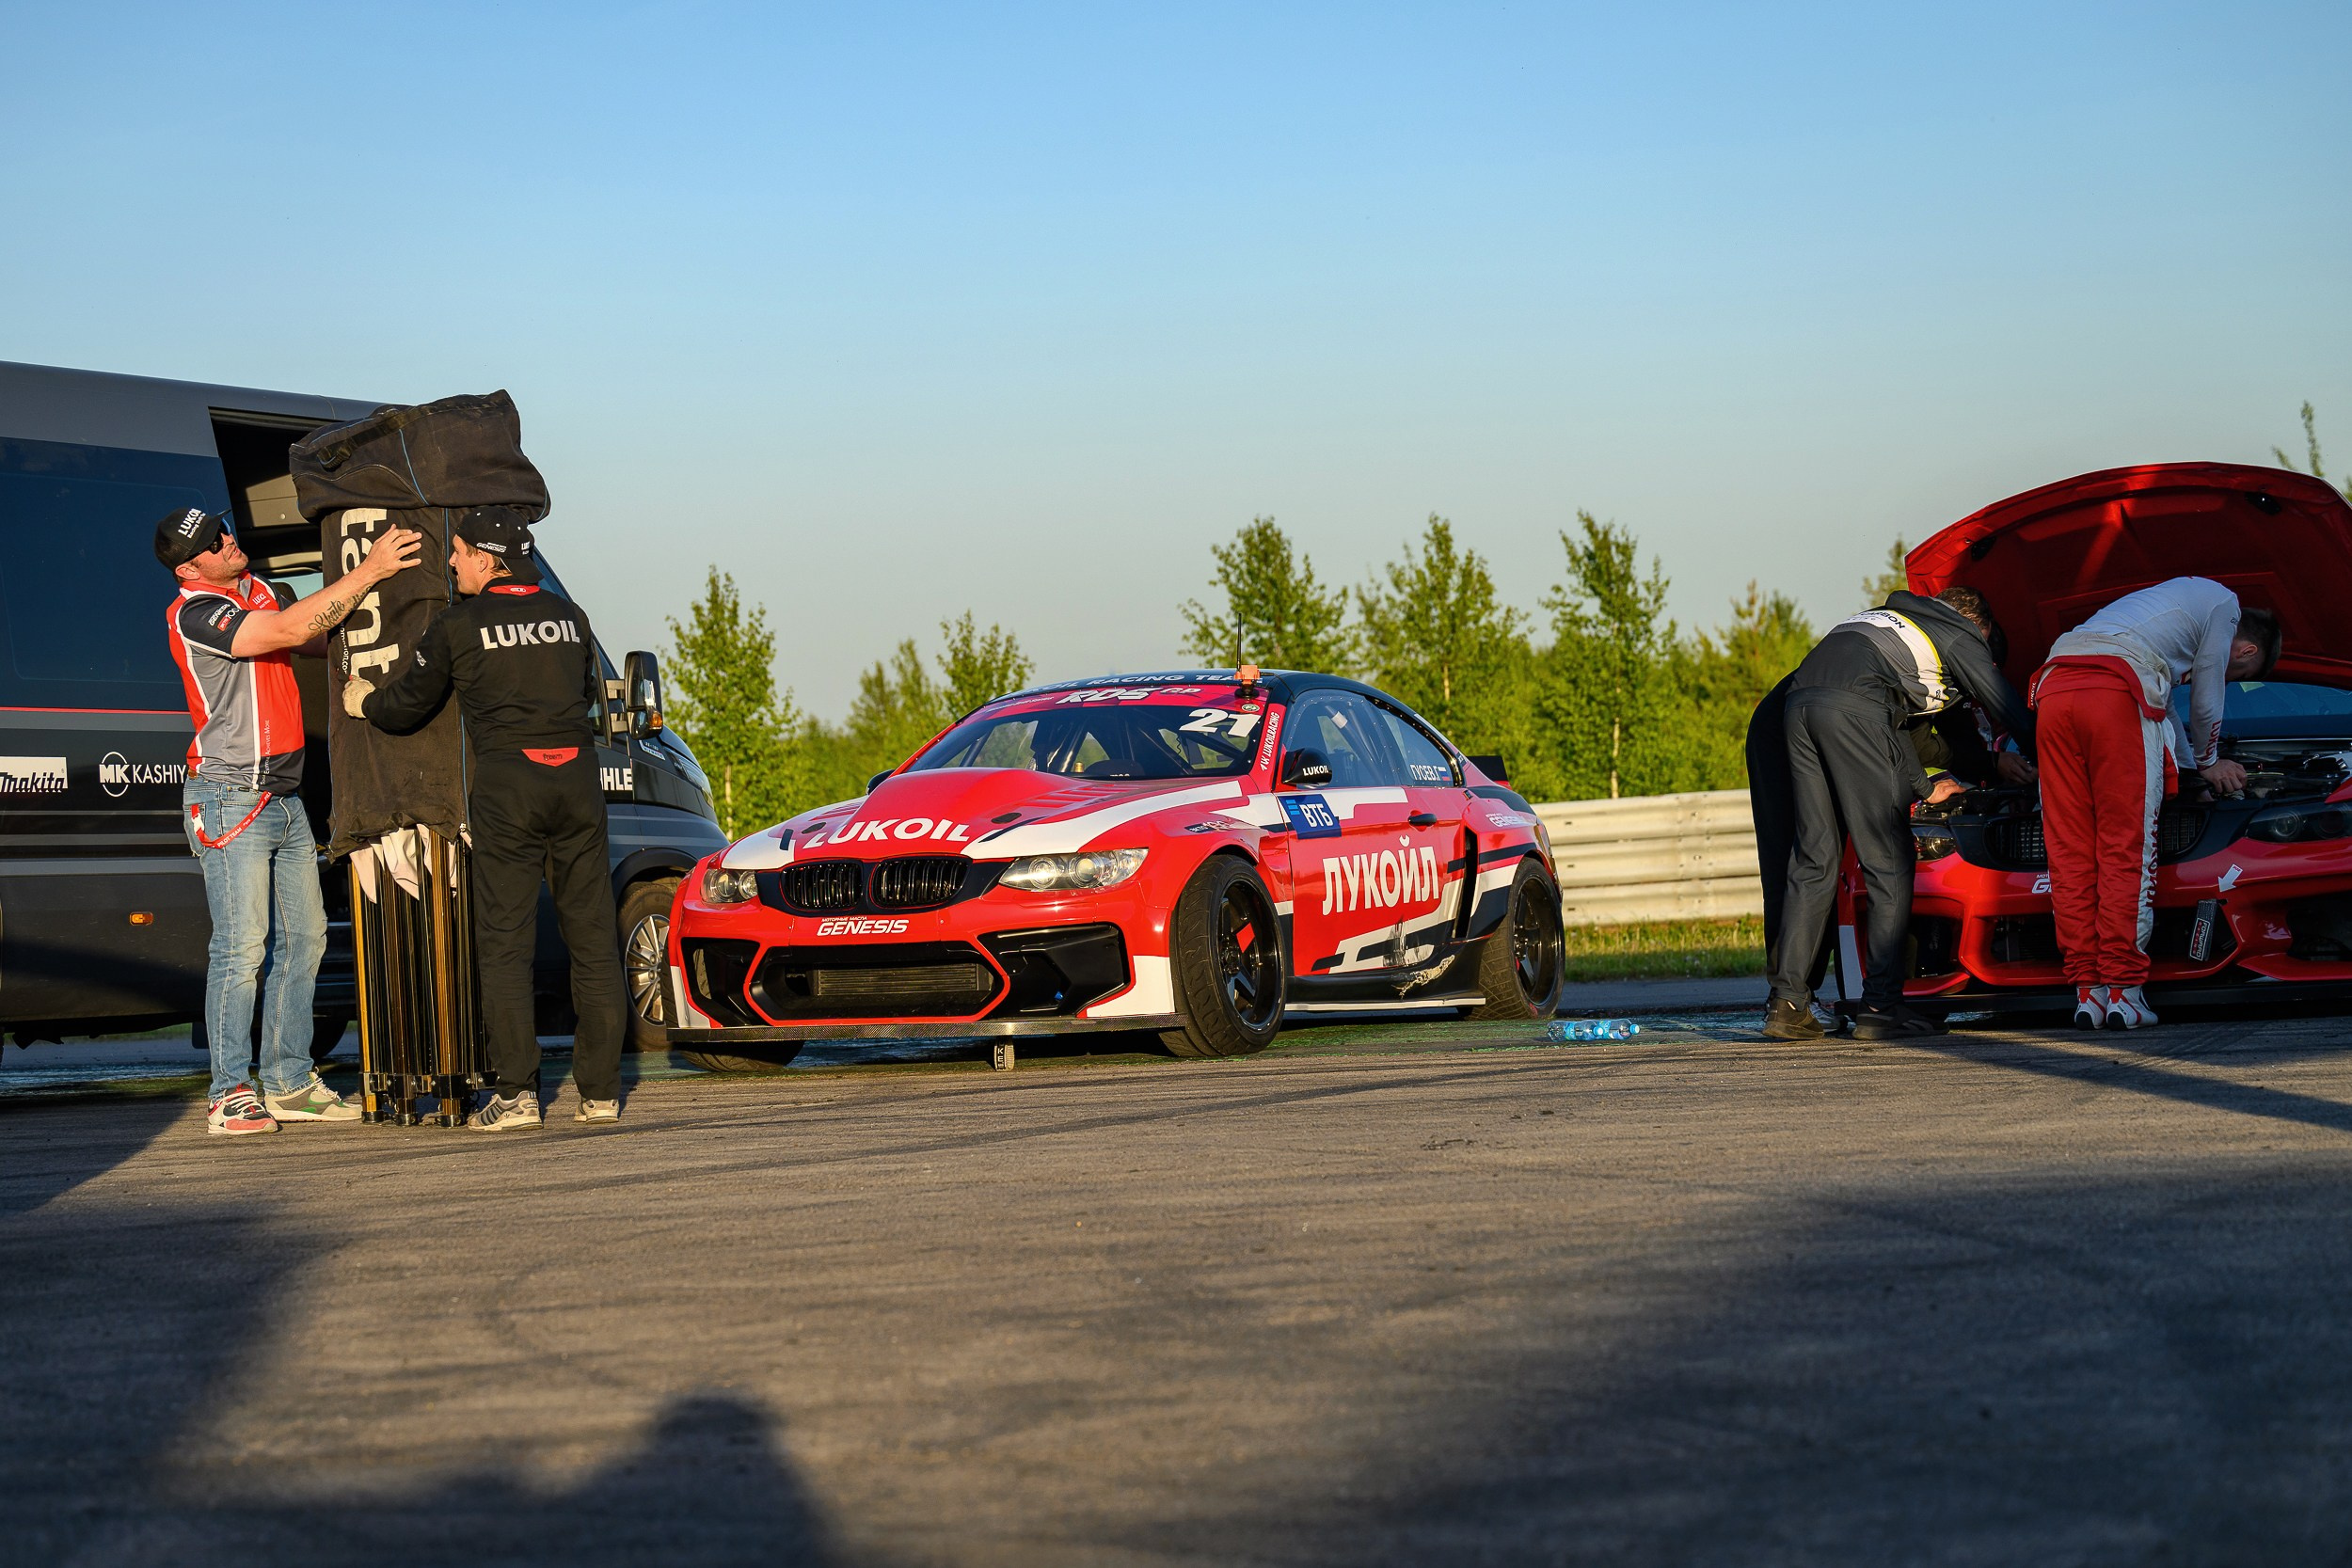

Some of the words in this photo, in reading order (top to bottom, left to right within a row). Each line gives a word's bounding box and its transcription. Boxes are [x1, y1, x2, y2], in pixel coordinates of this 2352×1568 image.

[480, 620, 580, 650] LUKOIL
[1086, 674, 1184, 686] RACING
[1056, 687, 1164, 705] RDS
[1179, 708, 1262, 737] 21
[99, 764, 131, 784] MK
[133, 764, 186, 784] KASHIY
[600, 767, 633, 791] HLE
[1302, 765, 1328, 776] LUKOIL
[1299, 803, 1334, 828] ВТБ
[216, 834, 230, 847] PILOT
[230, 827, 243, 838] TEAM
[802, 817, 970, 849] LUKOIL
[1322, 834, 1439, 916] ЛУКОЙЛ
[817, 919, 910, 937] GENESIS
[2196, 922, 2207, 958] FORWARD
